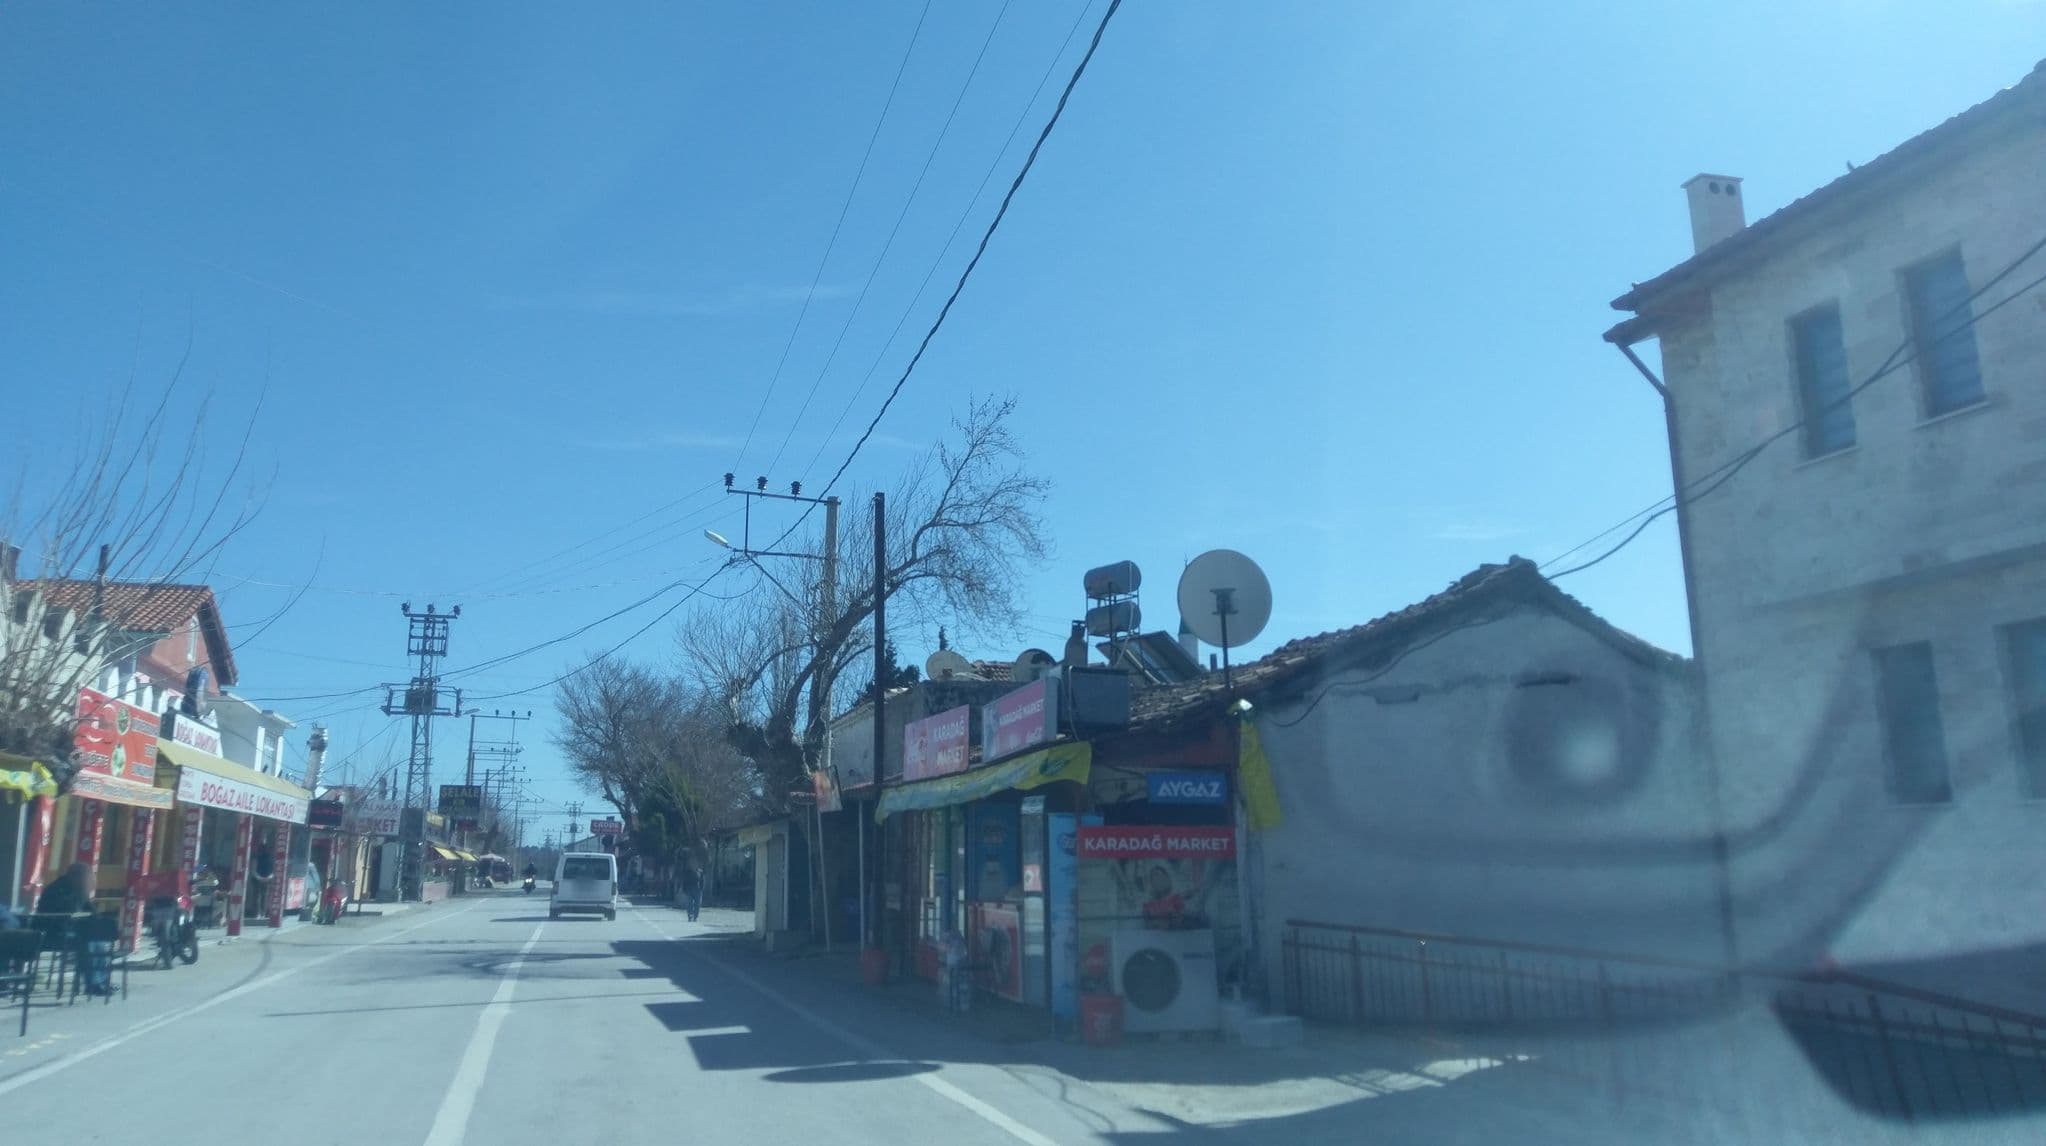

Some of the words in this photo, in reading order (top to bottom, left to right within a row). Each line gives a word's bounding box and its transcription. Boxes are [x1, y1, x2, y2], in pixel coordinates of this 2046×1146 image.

[1023, 698, 1044, 716] MARKET
[936, 744, 964, 767] MARKET
[1158, 781, 1221, 798] AYGAZ
[1085, 834, 1162, 851] KARADAĞ
[1167, 838, 1230, 851] MARKET
